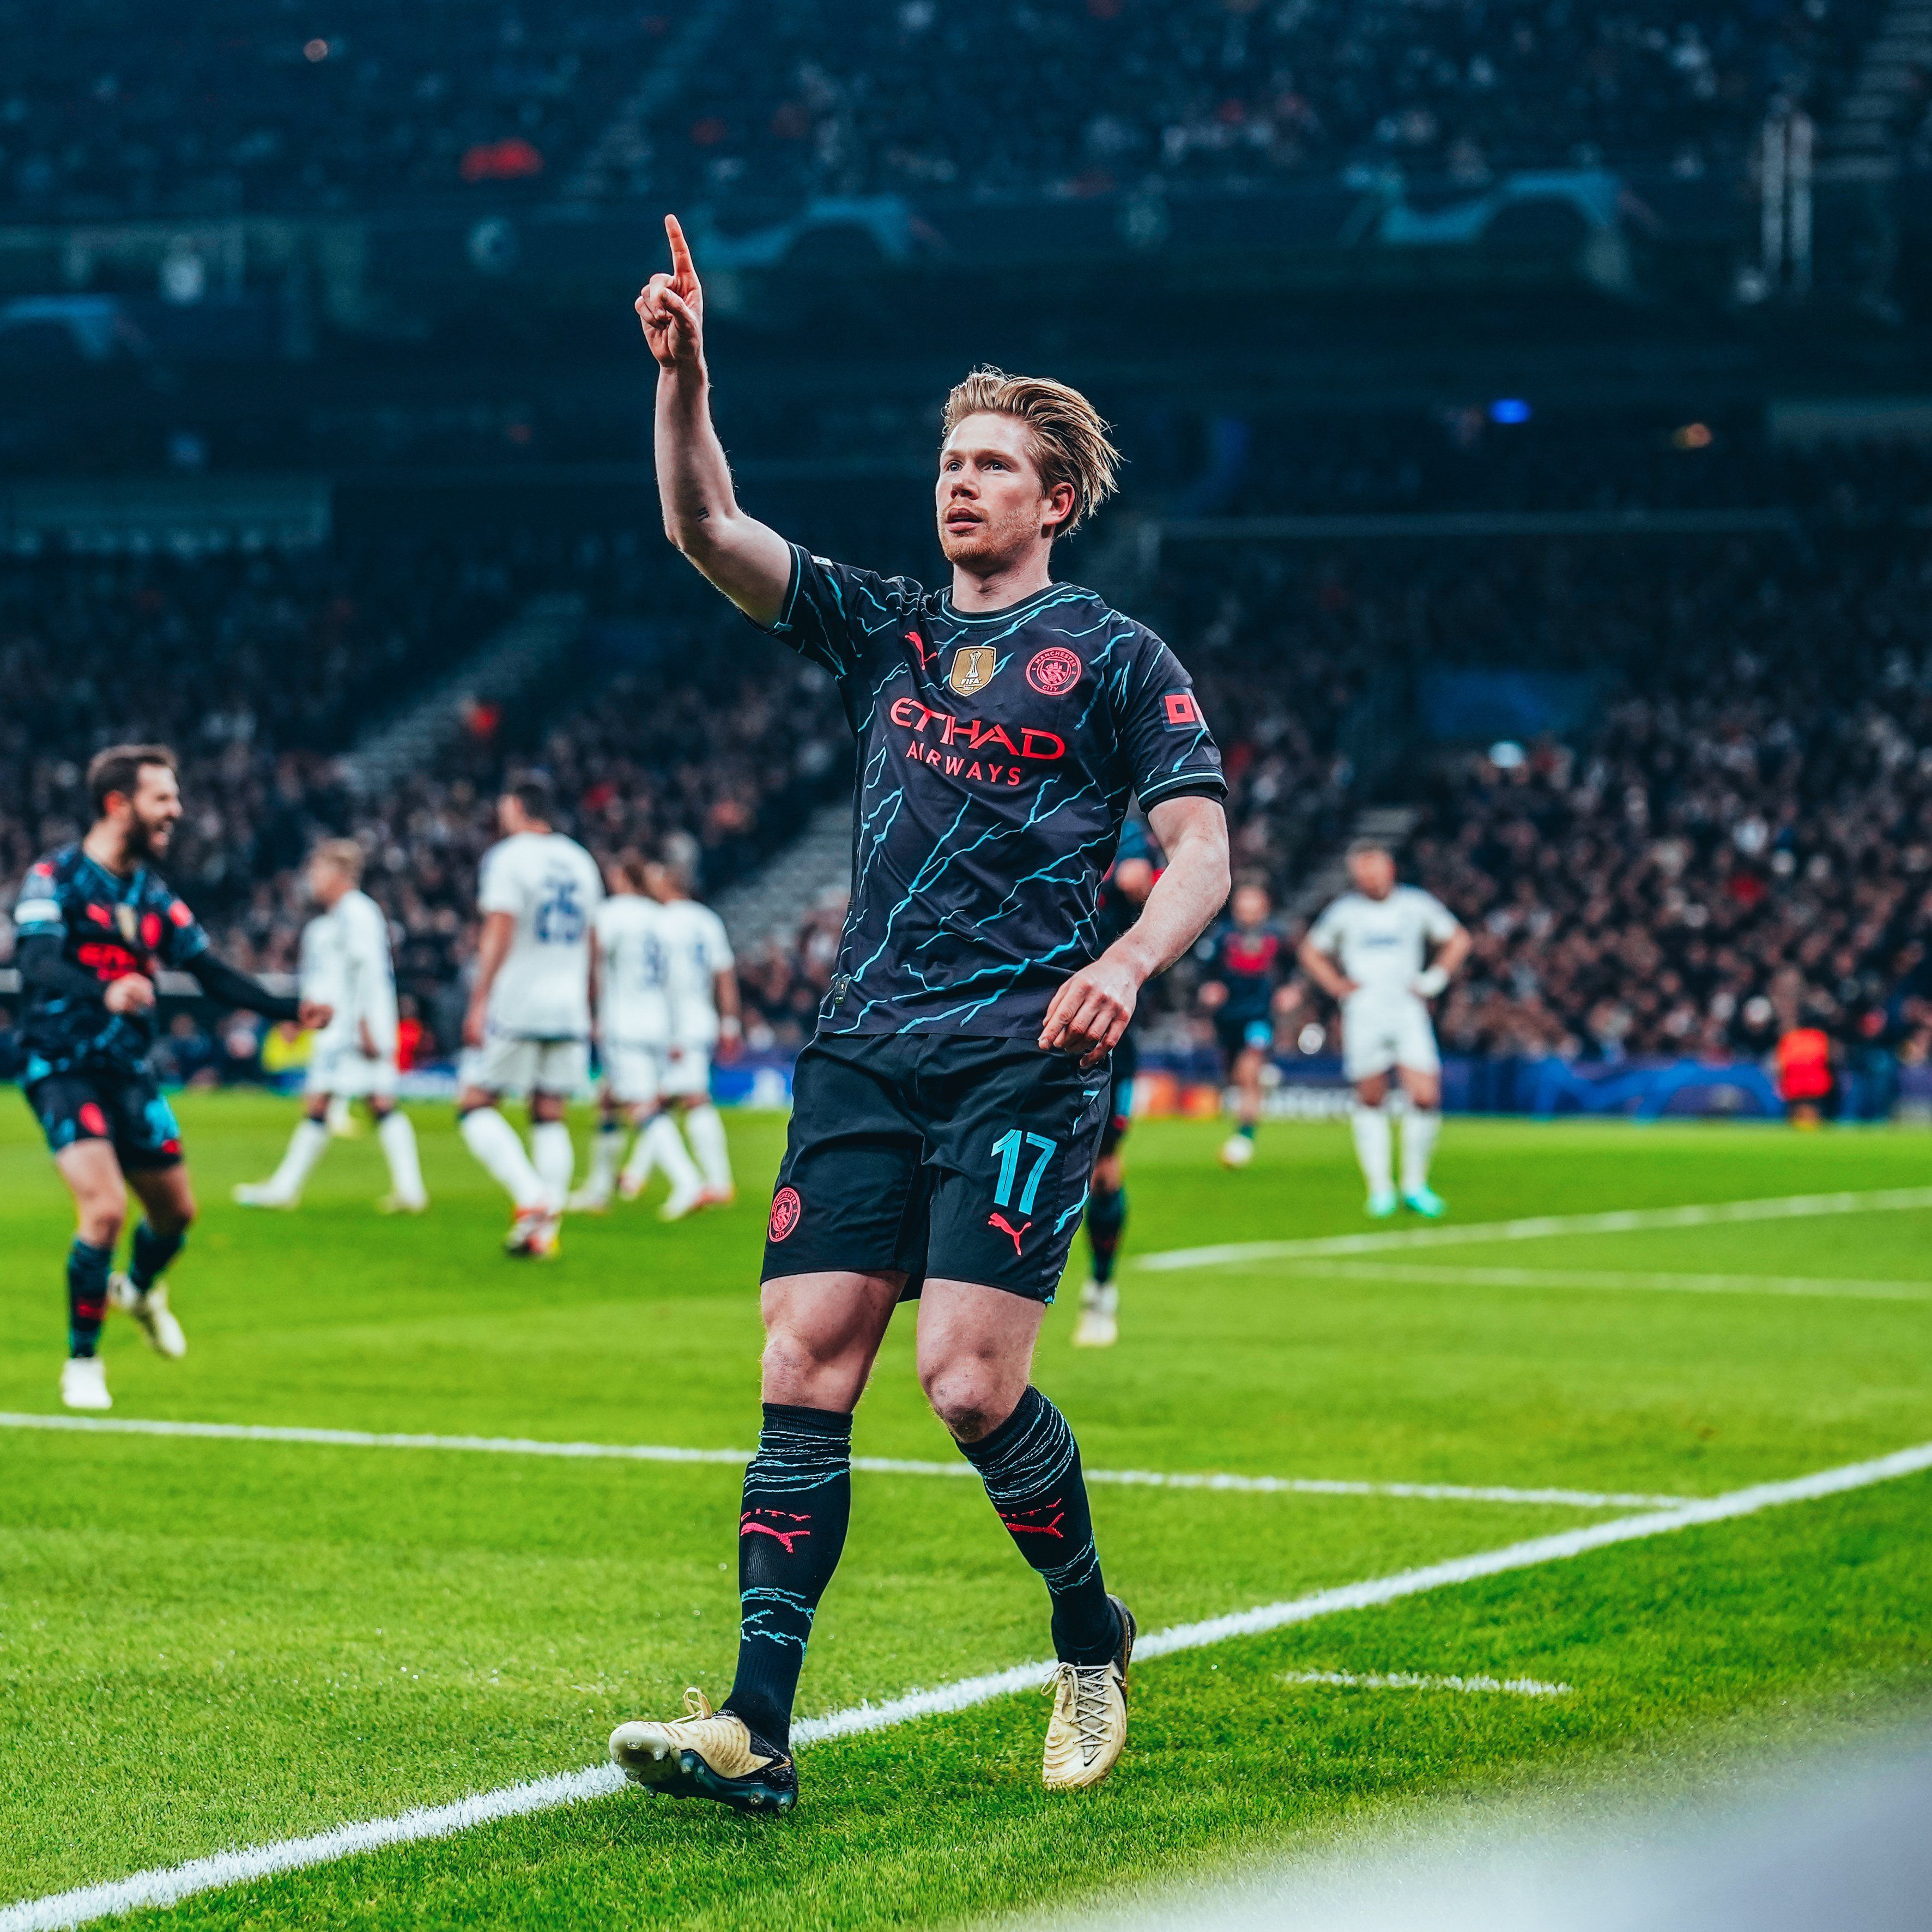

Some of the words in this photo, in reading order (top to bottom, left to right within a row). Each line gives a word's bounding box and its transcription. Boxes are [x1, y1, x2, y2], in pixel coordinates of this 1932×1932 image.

[1035, 651, 1077, 668] MANCHESTER
[890, 697, 1065, 760] ETIHAD
[905, 740, 1021, 786] AIRWAYS
[991, 1129, 1057, 1216] 17
